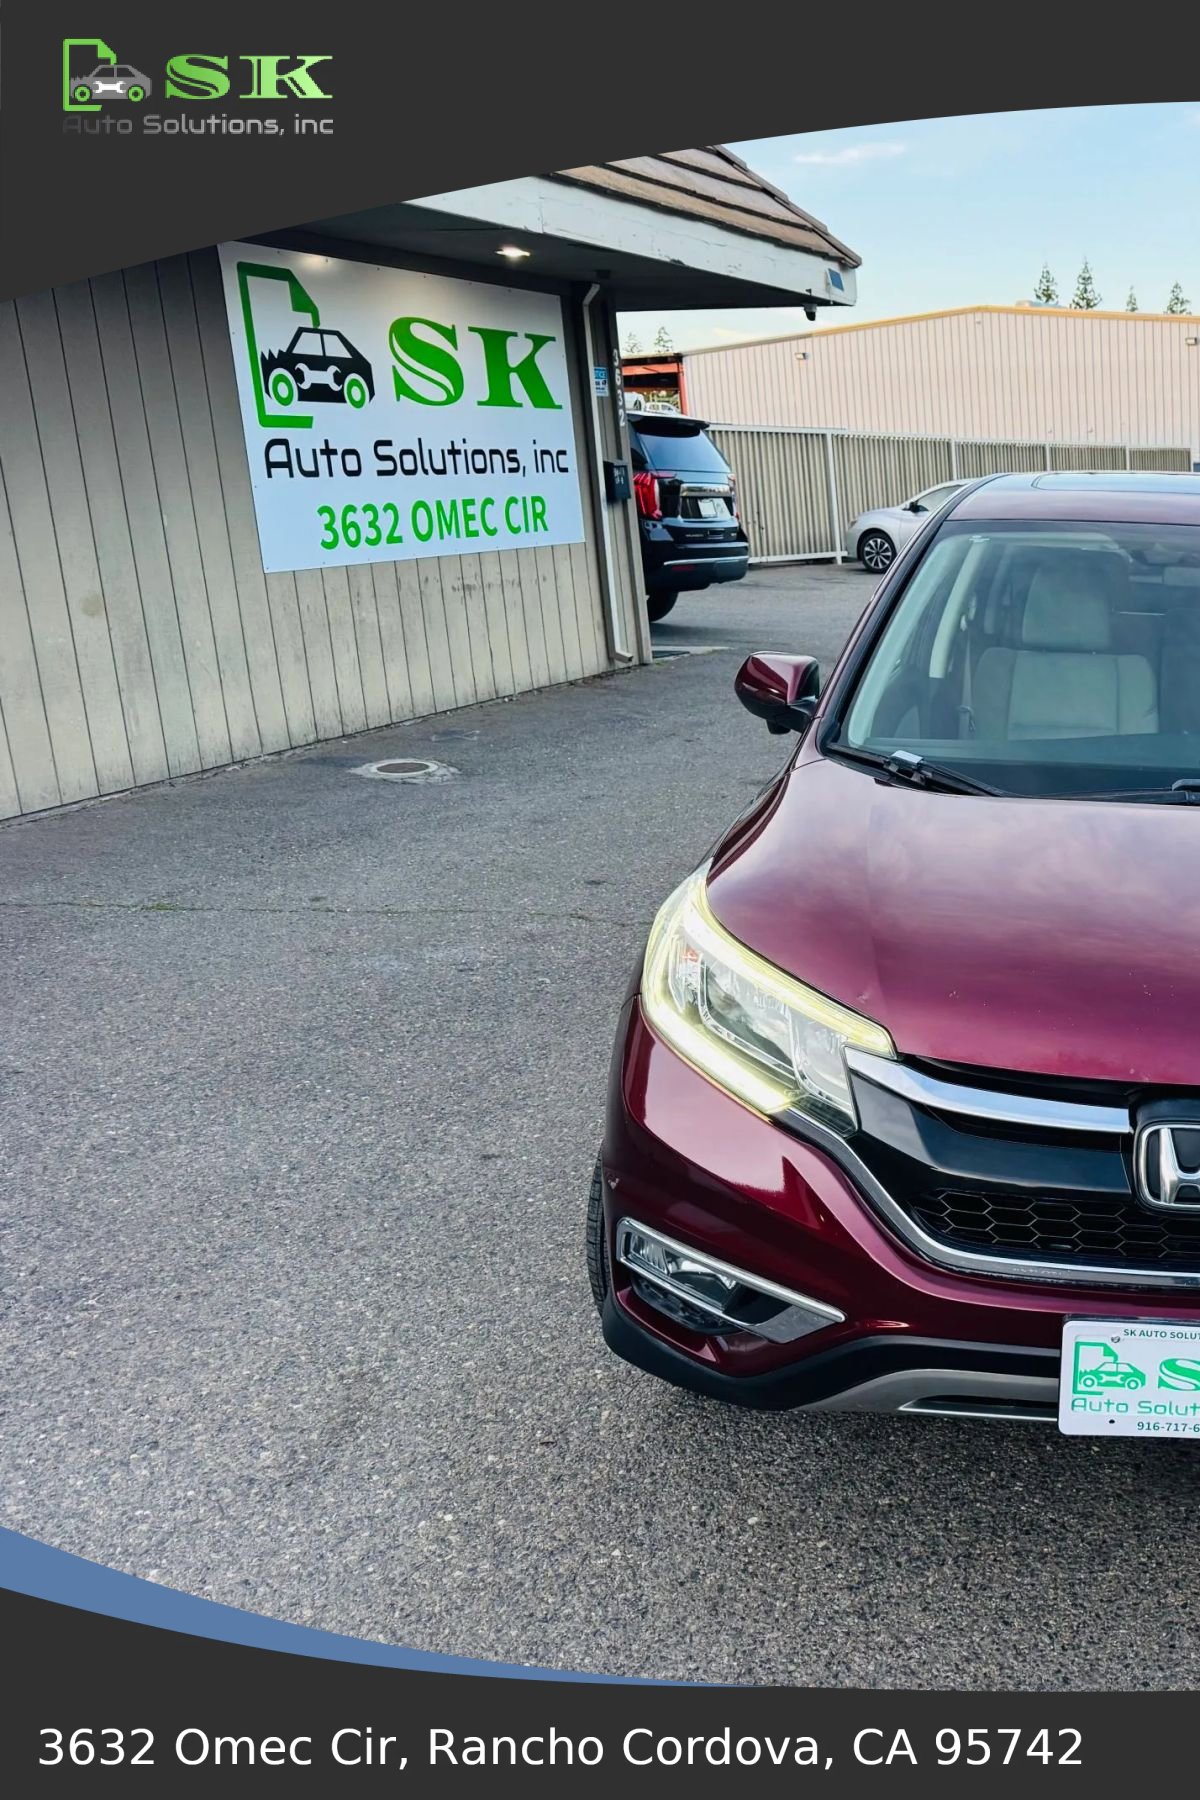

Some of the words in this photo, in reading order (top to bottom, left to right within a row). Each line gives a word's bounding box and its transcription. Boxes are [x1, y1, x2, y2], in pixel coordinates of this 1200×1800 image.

[388, 316, 563, 410] SK
[264, 438, 362, 479] Auto
[373, 438, 526, 477] Solutions,
[533, 439, 569, 473] inc
[316, 502, 404, 550] 3632
[411, 496, 499, 543] OMEC
[504, 495, 549, 533] CIR
[1123, 1328, 1137, 1337] SK
[1139, 1330, 1168, 1338] AUTO
[1071, 1397, 1129, 1414] Auto
